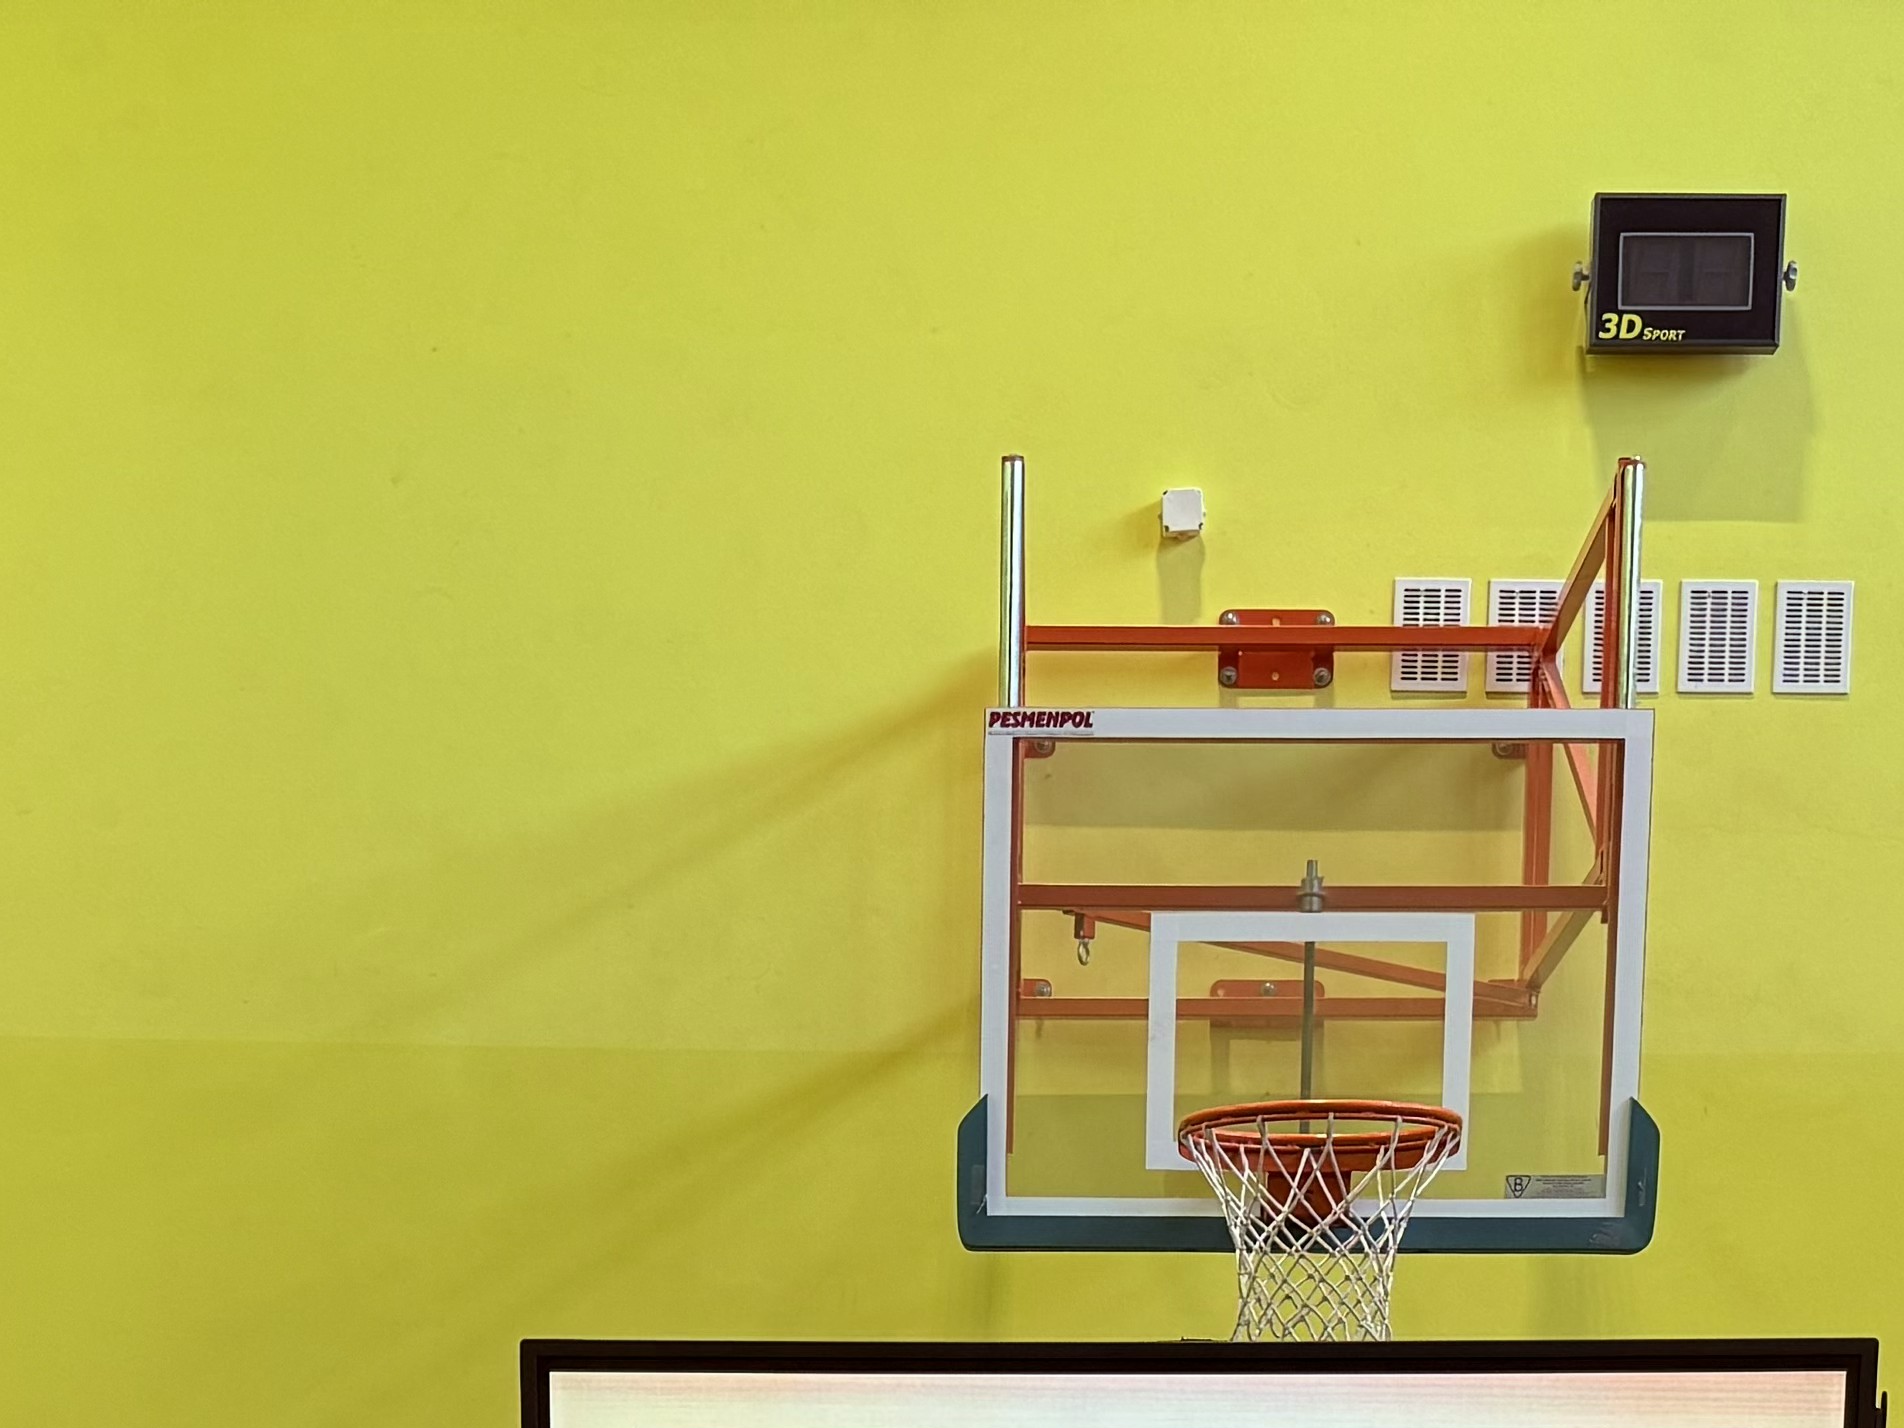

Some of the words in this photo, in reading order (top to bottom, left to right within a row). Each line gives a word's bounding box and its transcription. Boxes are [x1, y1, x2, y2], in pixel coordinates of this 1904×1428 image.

[1598, 313, 1643, 339] 3D
[1643, 328, 1685, 341] SPORT
[988, 711, 1093, 728] PESMENPOL
